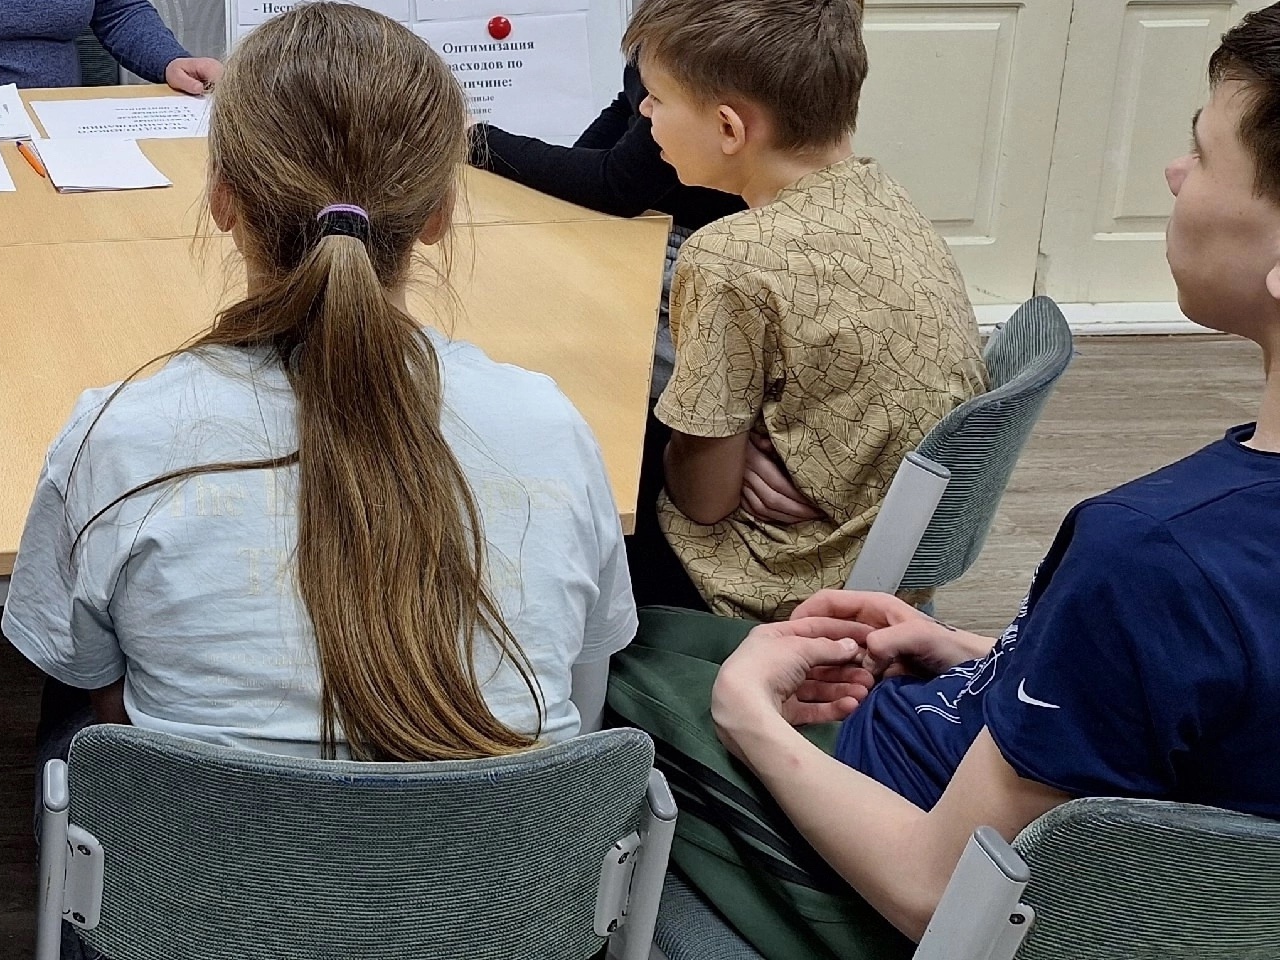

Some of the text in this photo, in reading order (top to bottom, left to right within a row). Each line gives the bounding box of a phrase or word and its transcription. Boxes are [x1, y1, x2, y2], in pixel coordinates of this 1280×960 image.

[442, 41, 535, 54] Оптимизация
[507, 60, 523, 69] по
[464, 79, 513, 89] ичине:
